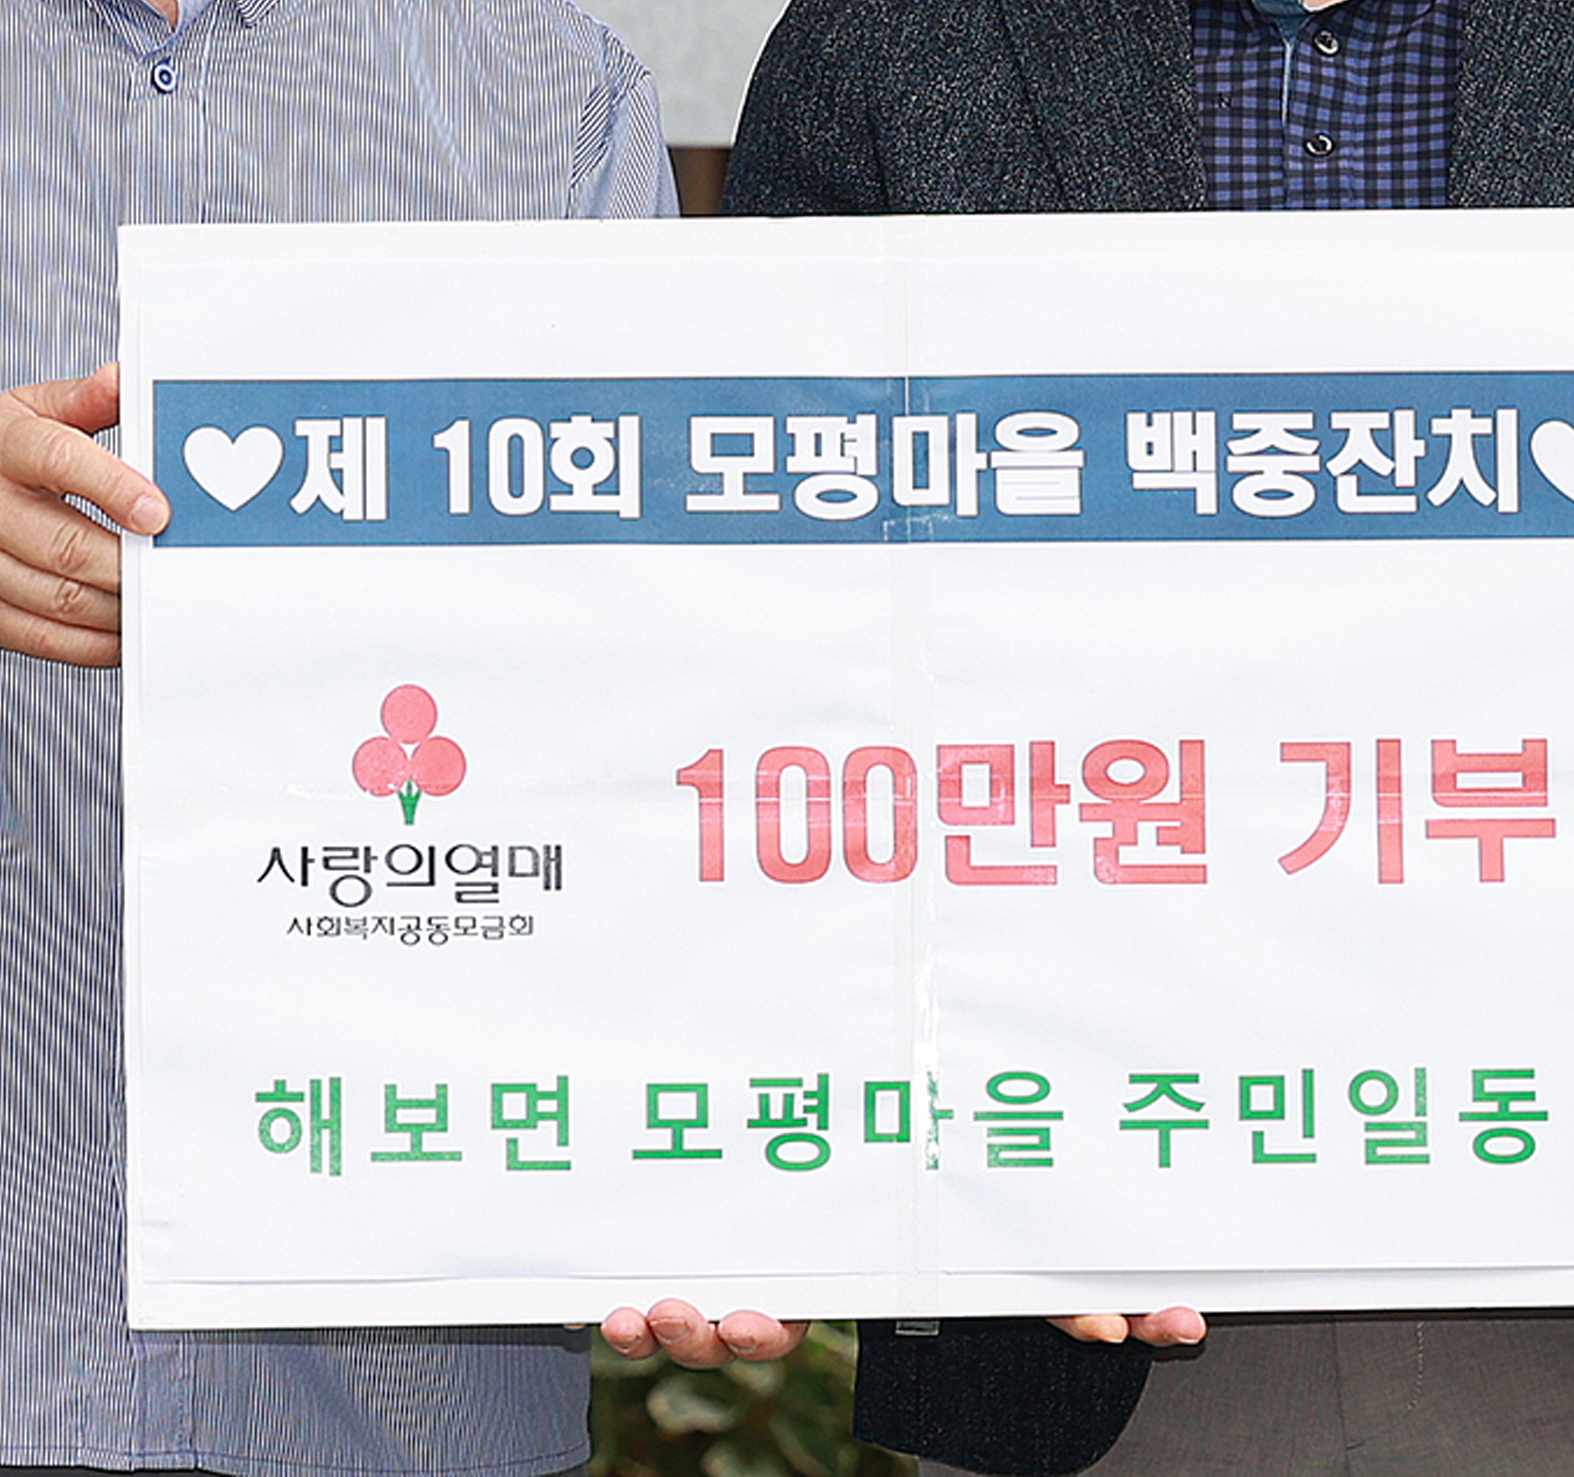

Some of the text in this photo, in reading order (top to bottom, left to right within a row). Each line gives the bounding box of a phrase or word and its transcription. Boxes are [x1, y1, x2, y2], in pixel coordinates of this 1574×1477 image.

[288, 408, 1520, 522] 제 10회 모평마을 백중잔치
[675, 737, 1558, 887] 100만원 기부
[256, 842, 563, 909] 사랑의열매
[286, 914, 534, 946] 사회복지공동모금회
[256, 1066, 1550, 1177] 해보면 모평마을 주민일동
